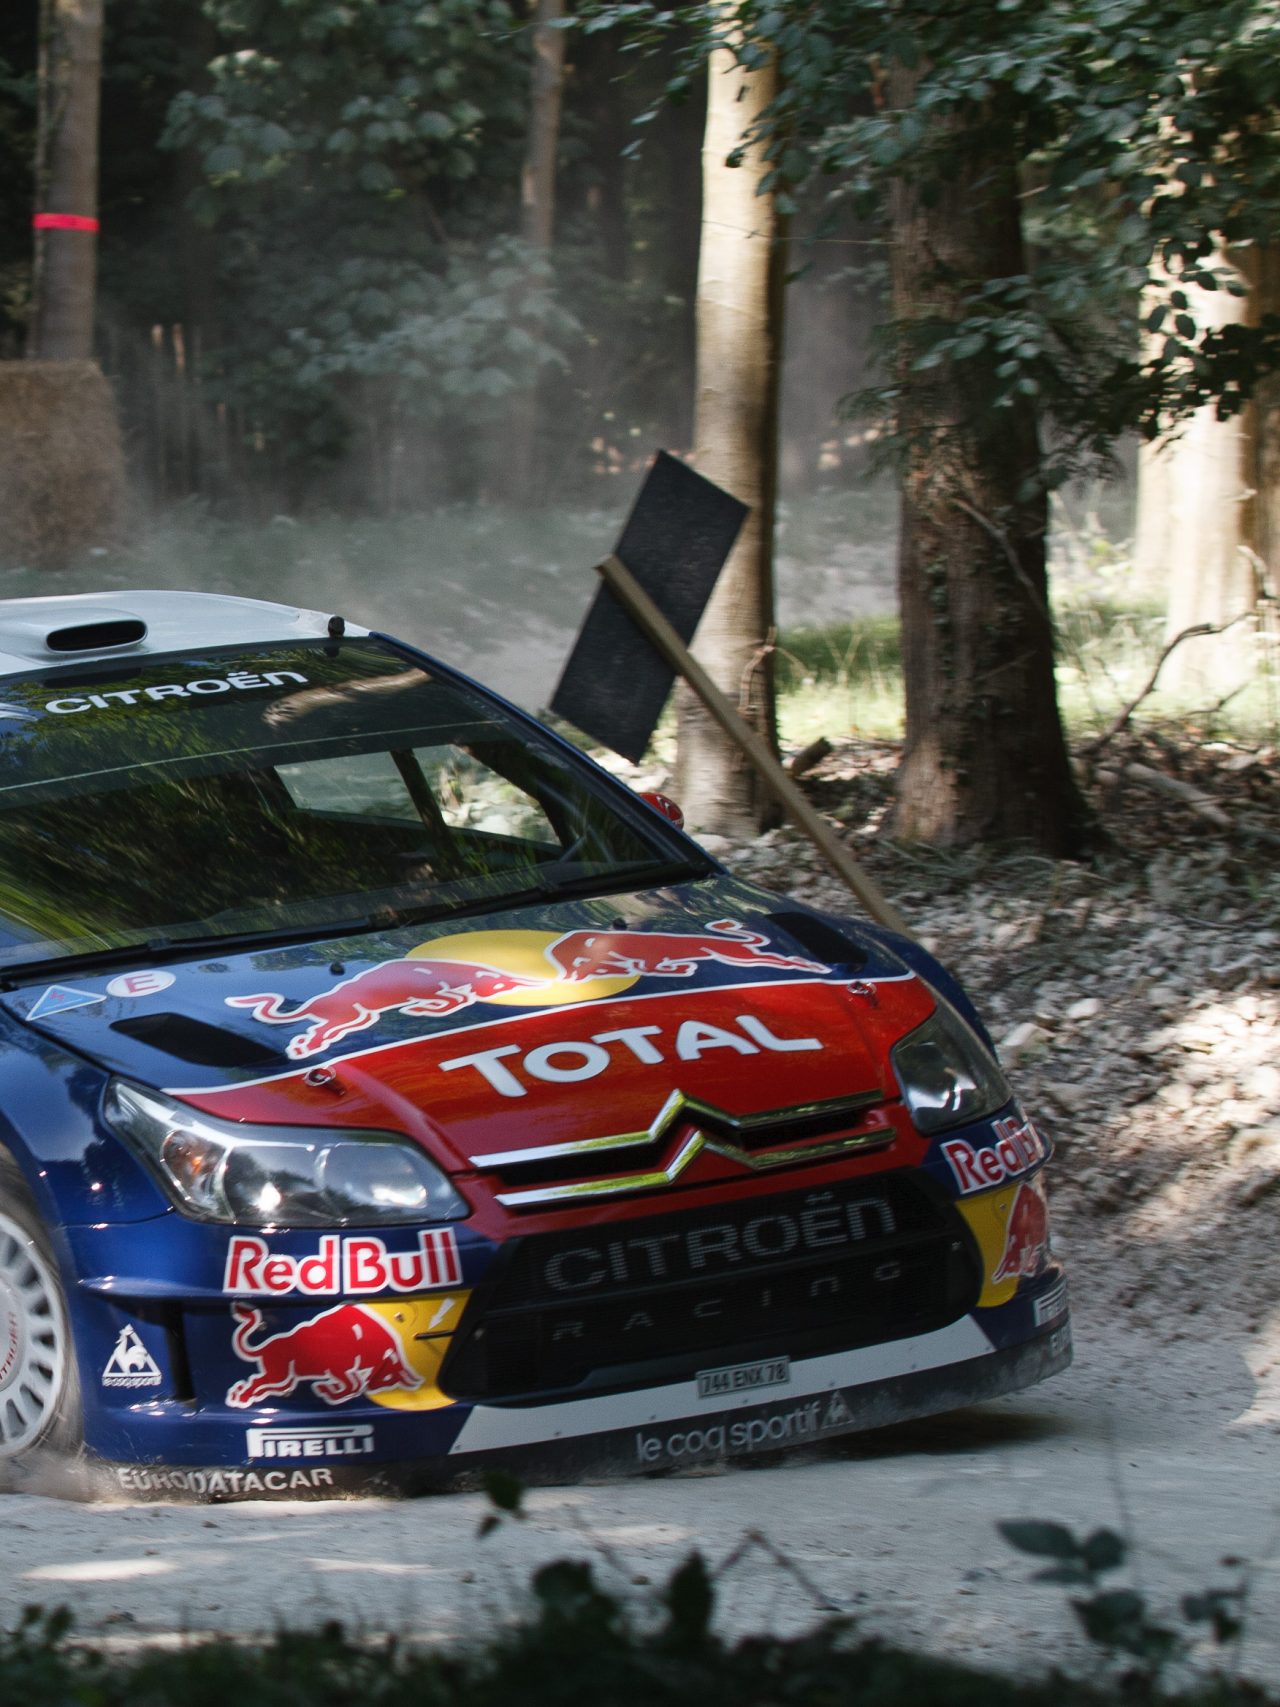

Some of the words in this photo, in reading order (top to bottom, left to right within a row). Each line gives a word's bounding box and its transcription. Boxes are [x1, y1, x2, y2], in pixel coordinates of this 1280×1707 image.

[45, 670, 309, 715] CITROËN
[124, 973, 160, 994] E
[438, 1014, 825, 1098] TOTAL
[543, 1191, 897, 1292] CITROËN
[766, 1362, 787, 1382] 78
[246, 1424, 374, 1459] PIRELLI
[635, 1431, 663, 1463] le
[666, 1423, 727, 1457] coq
[729, 1399, 821, 1452] sportif
